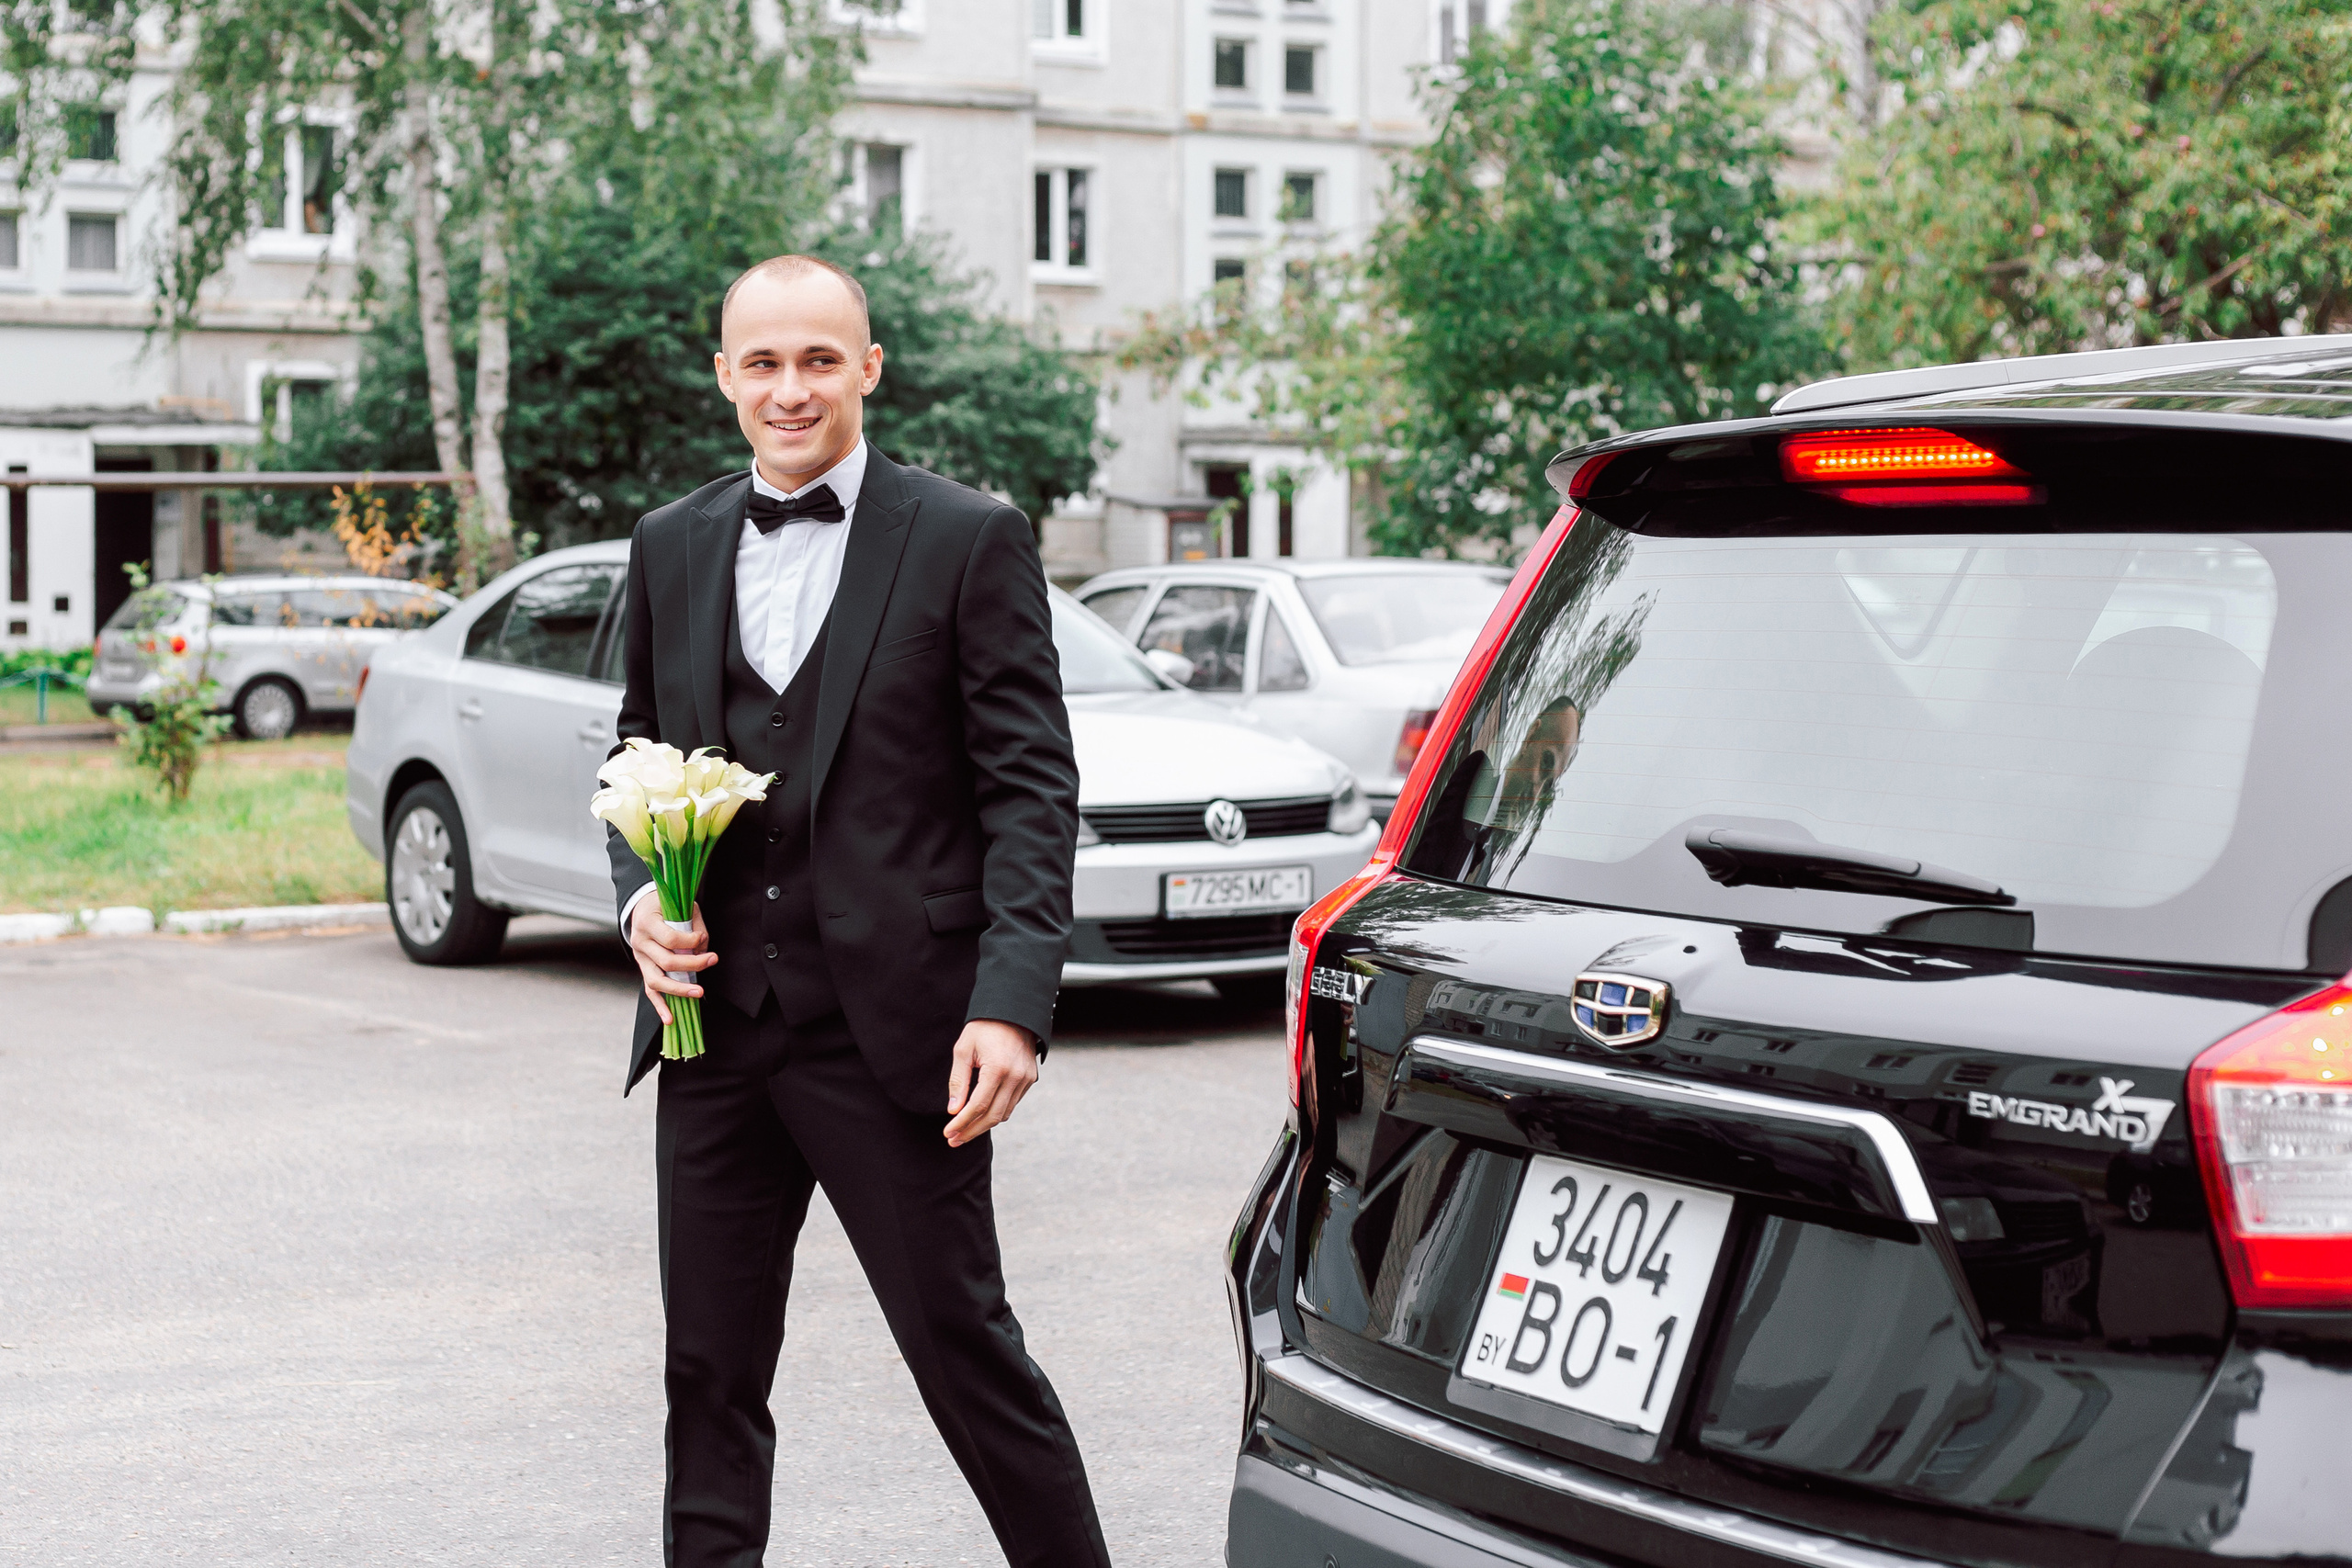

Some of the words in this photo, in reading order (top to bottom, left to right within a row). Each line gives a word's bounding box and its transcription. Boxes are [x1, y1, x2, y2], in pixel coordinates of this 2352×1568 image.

[1969, 1091, 2148, 1143] EMGRAND
[1533, 1176, 1683, 1297] 3404
[1476, 1334, 1506, 1365] BY
[1506, 1280, 1678, 1411] BO-1
